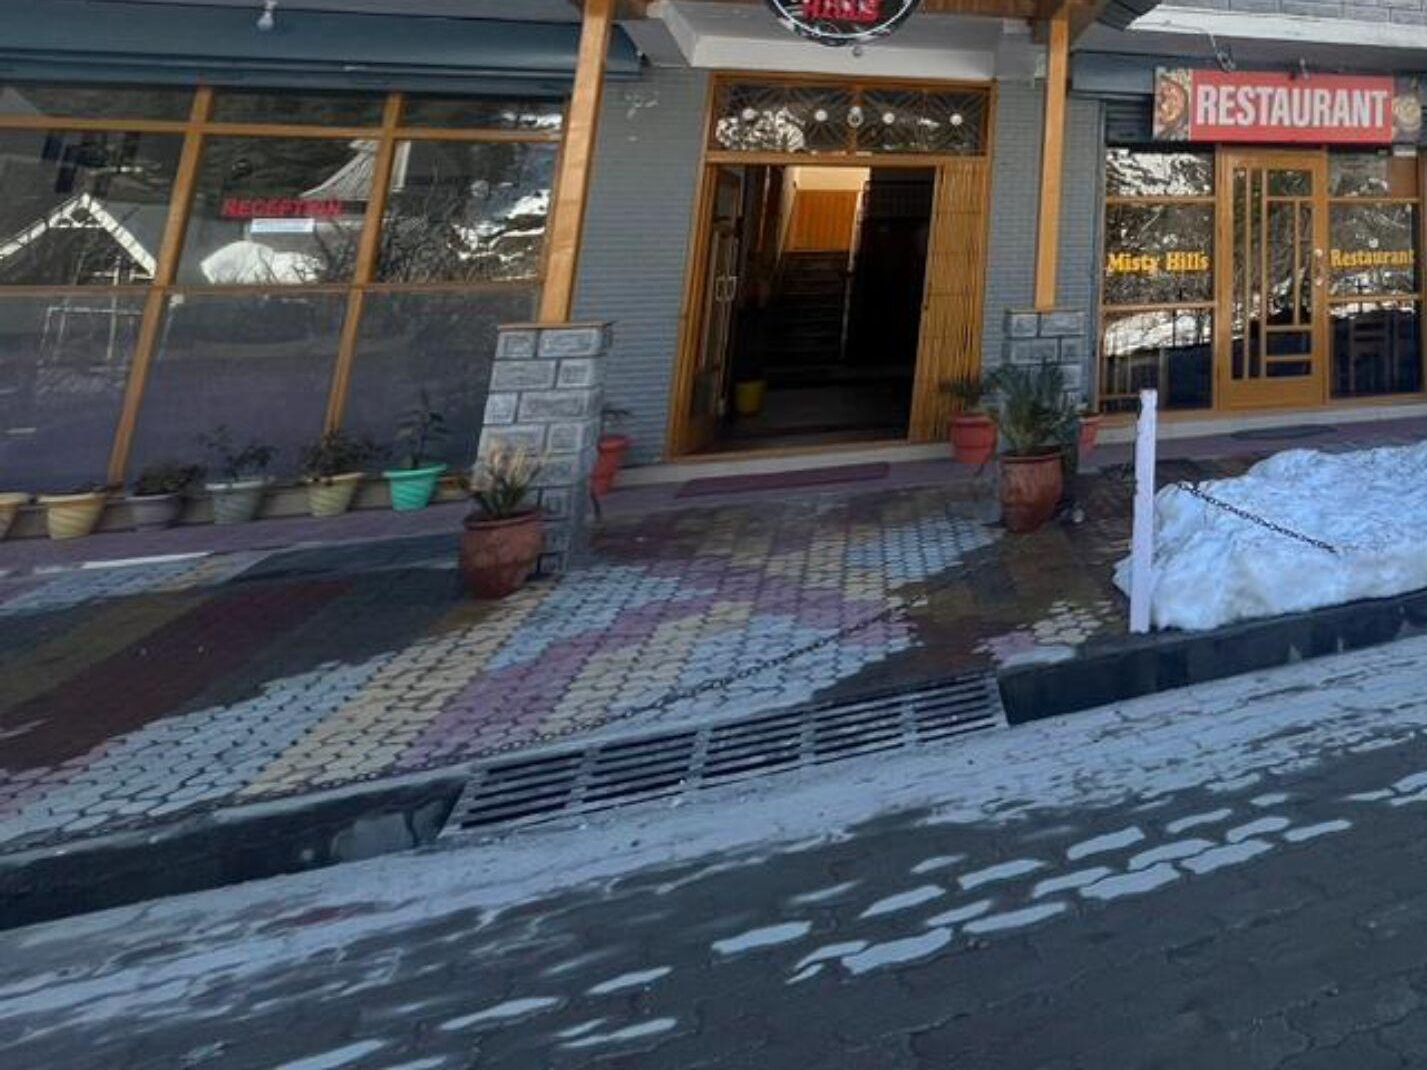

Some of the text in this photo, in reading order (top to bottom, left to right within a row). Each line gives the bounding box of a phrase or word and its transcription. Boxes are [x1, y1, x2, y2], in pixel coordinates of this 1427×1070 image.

[1196, 84, 1387, 128] RESTAURANT
[1107, 250, 1209, 276] Misty Hills
[1331, 248, 1414, 267] Restaurant
